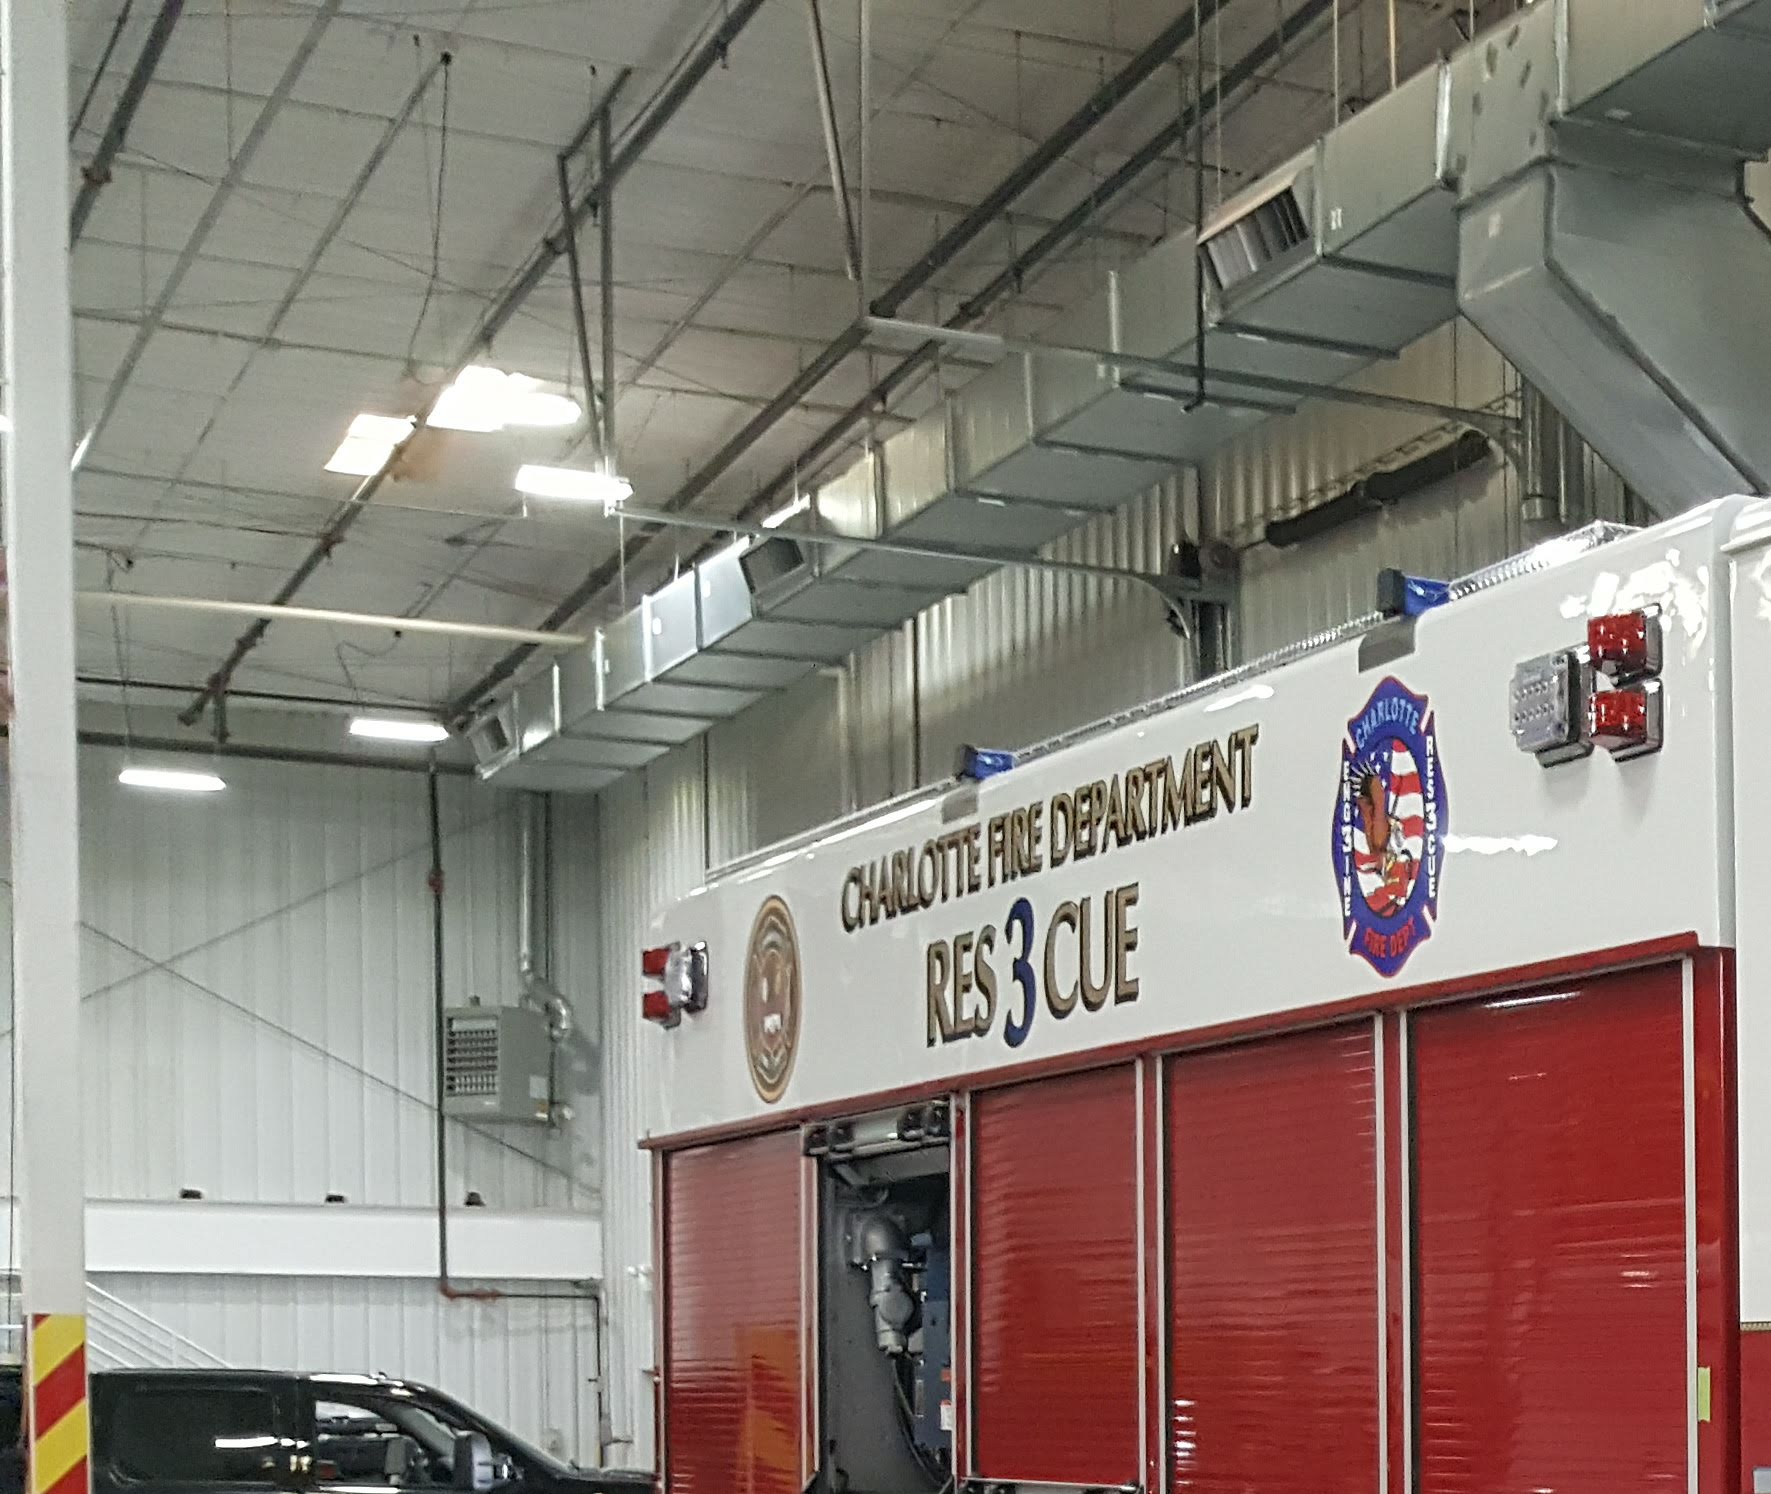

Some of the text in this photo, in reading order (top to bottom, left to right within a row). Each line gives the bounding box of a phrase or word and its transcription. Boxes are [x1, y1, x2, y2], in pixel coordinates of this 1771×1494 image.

[1355, 696, 1419, 749] CHARLOTTE
[841, 724, 1259, 933] CHARLOTTE FIRE DEPARTMENT
[1364, 927, 1387, 959] FIRE
